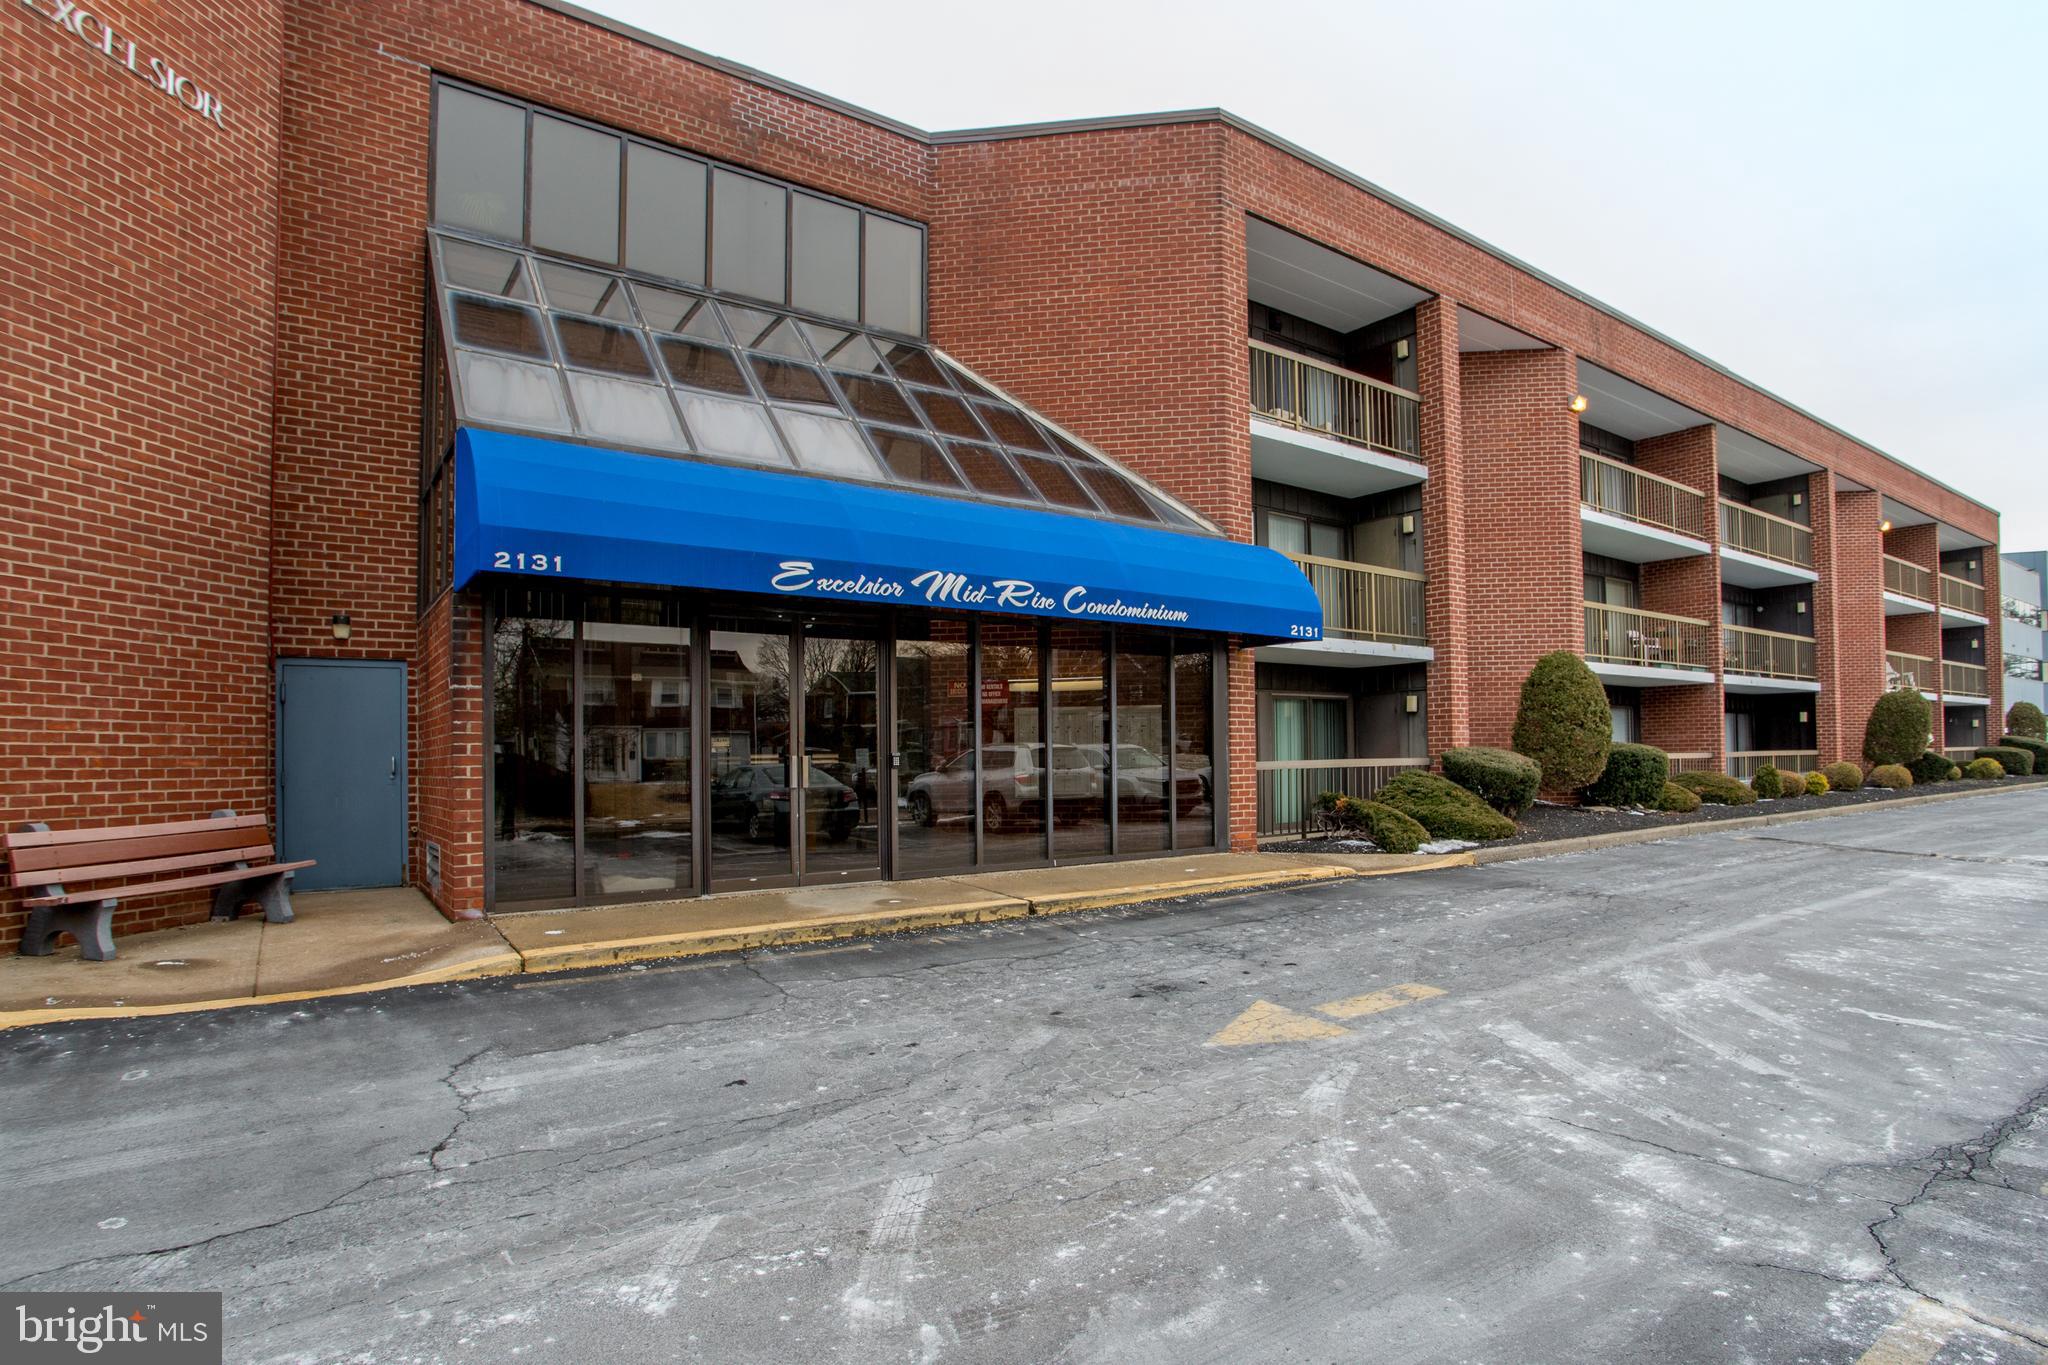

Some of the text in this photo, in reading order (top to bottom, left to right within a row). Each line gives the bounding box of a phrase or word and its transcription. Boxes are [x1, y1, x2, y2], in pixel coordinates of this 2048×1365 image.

[22, 0, 225, 131] XCELSIOR
[494, 551, 562, 572] 2131
[771, 561, 1189, 622] Excelsior Mid-Rise Condominium
[1290, 624, 1319, 638] 2131
